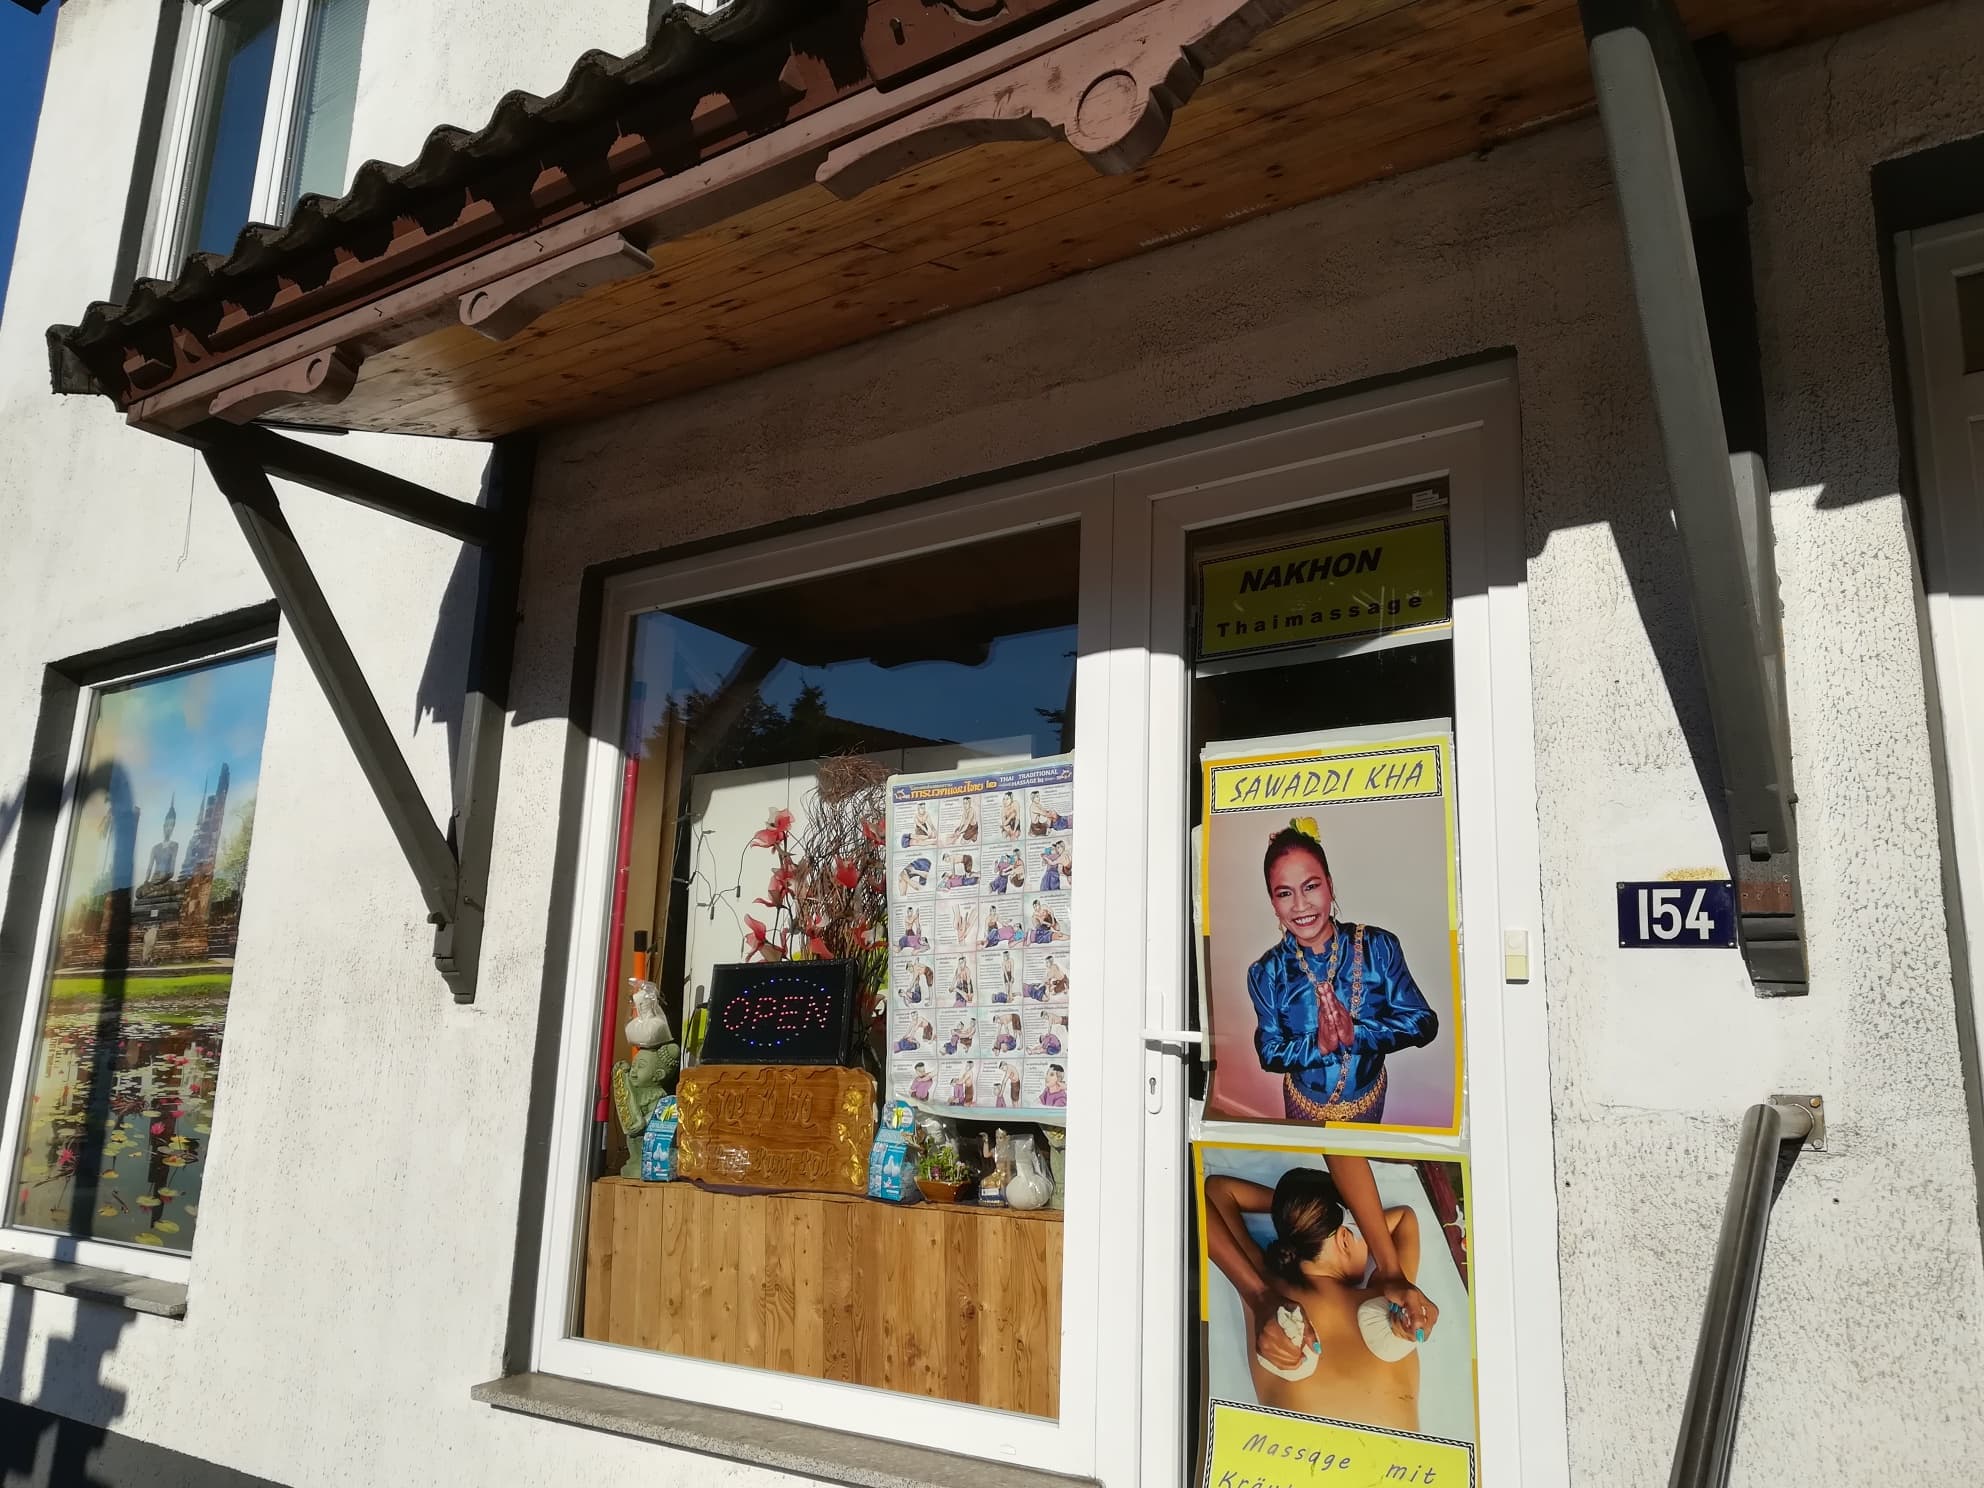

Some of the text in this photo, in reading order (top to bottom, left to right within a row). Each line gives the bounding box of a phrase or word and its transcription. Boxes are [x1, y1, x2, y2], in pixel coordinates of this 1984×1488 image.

[1239, 547, 1383, 594] NAKHON
[1217, 595, 1423, 638] Thaimassage
[1018, 769, 1058, 780] TRADITIONAL
[1230, 759, 1424, 803] SAWADDI KHA
[1638, 888, 1715, 940] 154
[723, 995, 832, 1030] OPEN
[1242, 1433, 1438, 1485] Massage mit
